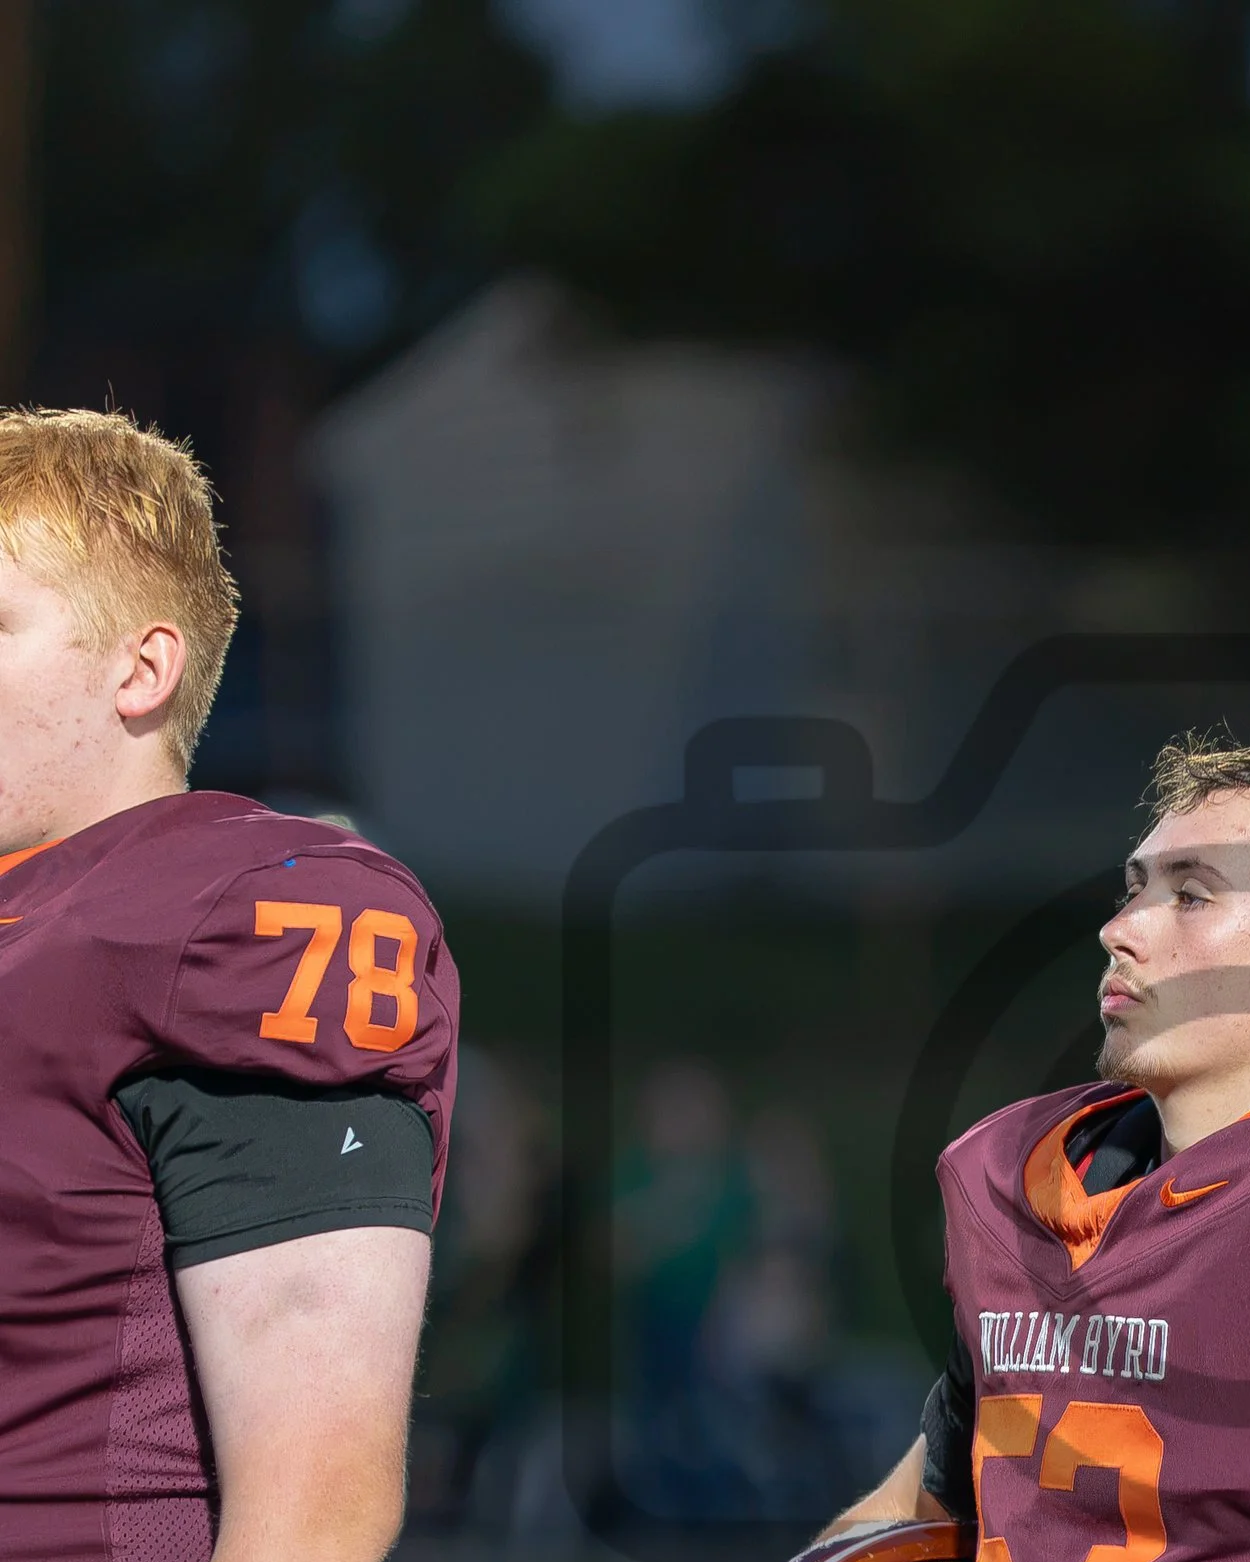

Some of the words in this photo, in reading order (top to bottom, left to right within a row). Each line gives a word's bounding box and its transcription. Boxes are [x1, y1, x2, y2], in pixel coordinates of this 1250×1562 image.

[255, 901, 418, 1053] 78
[978, 1311, 1077, 1375] WILLIAM
[1080, 1315, 1170, 1381] BYRD
